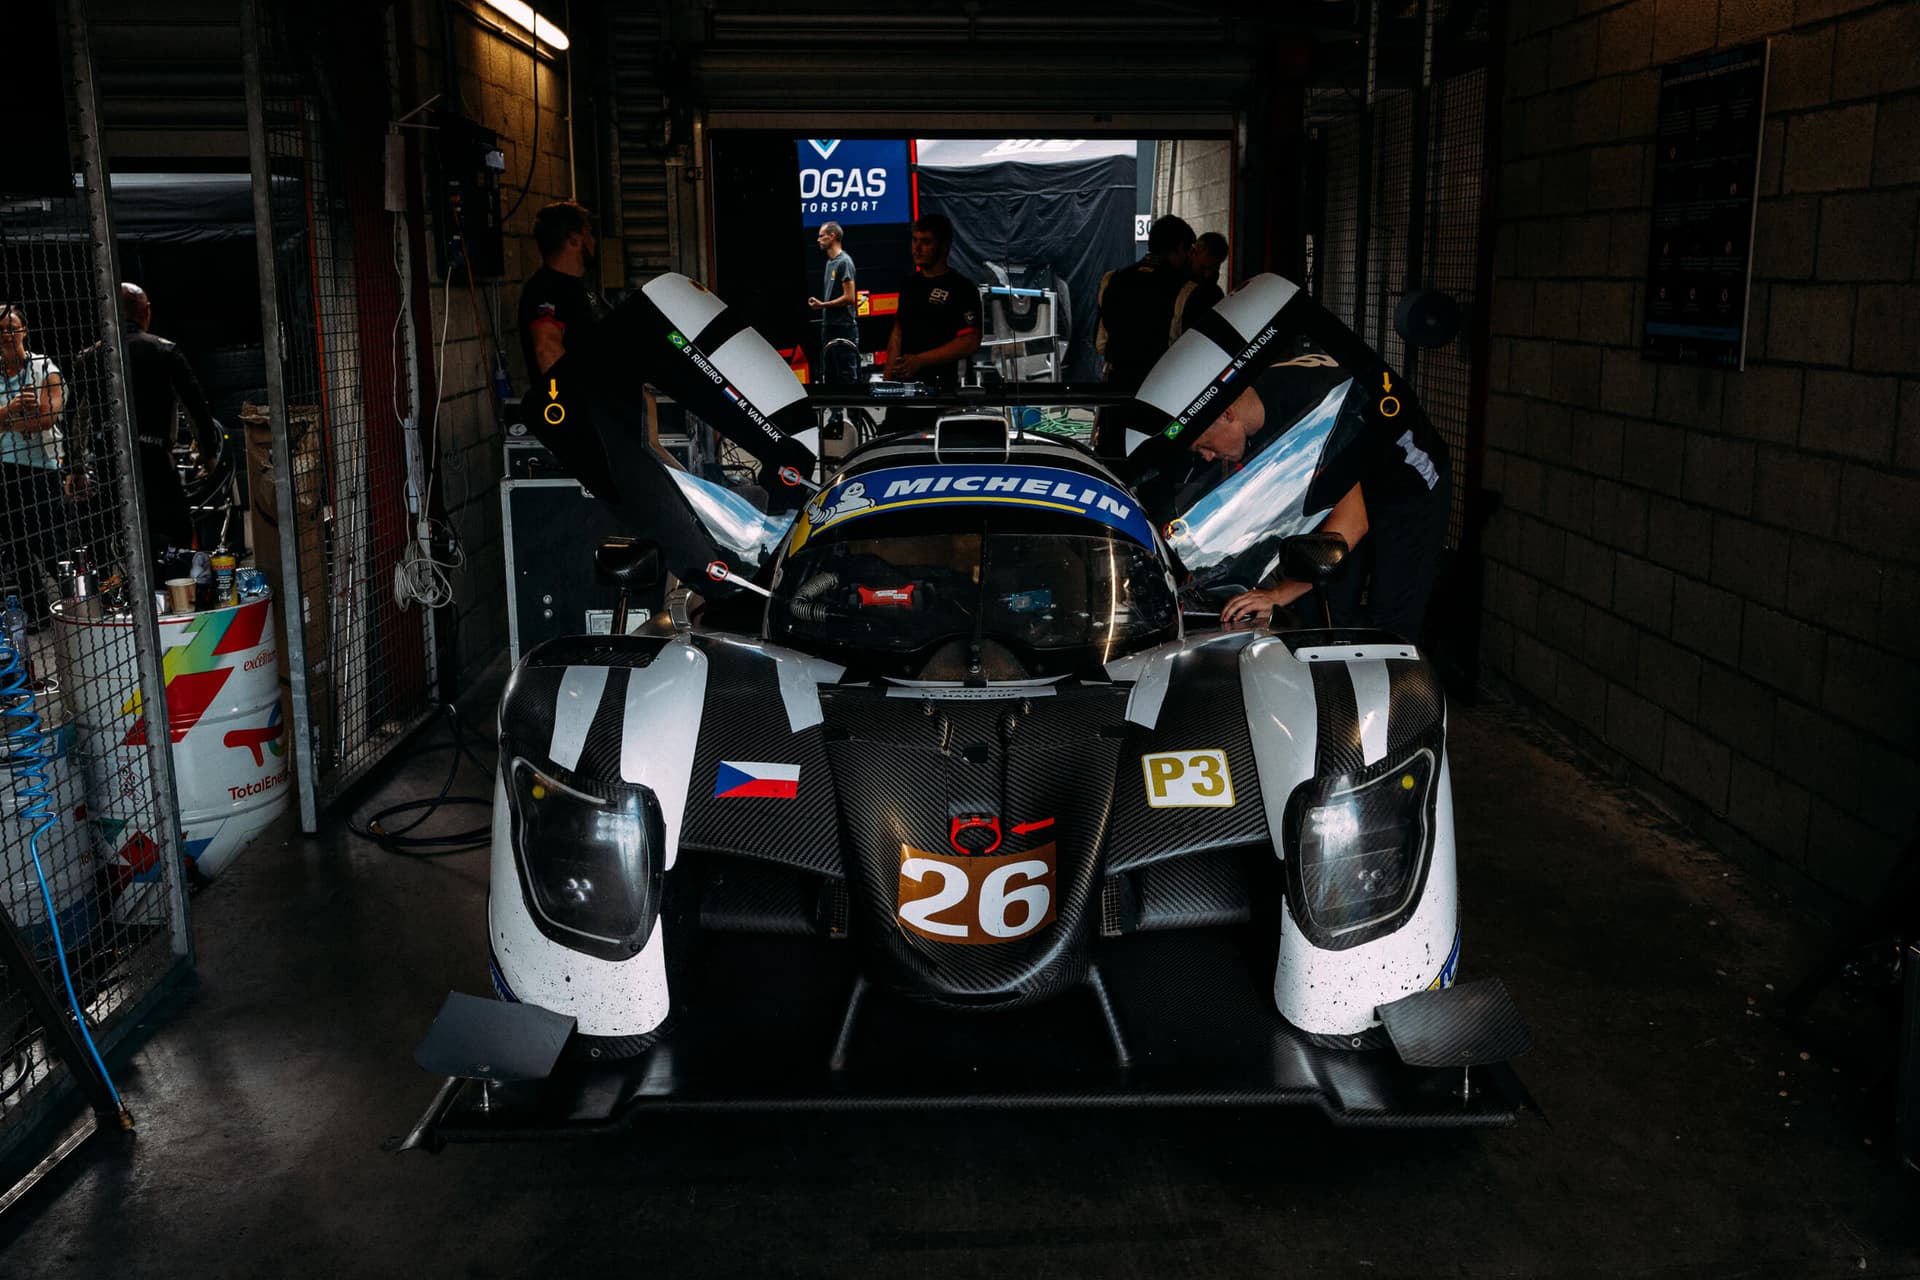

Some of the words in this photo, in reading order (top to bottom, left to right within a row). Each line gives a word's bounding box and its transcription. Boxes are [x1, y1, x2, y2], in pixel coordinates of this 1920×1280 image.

[800, 168, 887, 198] OGAS
[682, 345, 692, 356] B.
[691, 354, 723, 385] RIBEIRO
[1233, 359, 1246, 369] M.
[1242, 342, 1261, 360] VAN
[1259, 326, 1278, 346] DIJK
[737, 399, 747, 411] M.
[747, 407, 764, 425] VAN
[762, 423, 782, 443] DIJK
[1179, 415, 1190, 425] B.
[1187, 385, 1219, 417] RIBEIRO
[883, 476, 1130, 519] MICHELIN
[1148, 755, 1225, 798] P3
[899, 858, 1050, 938] 26
